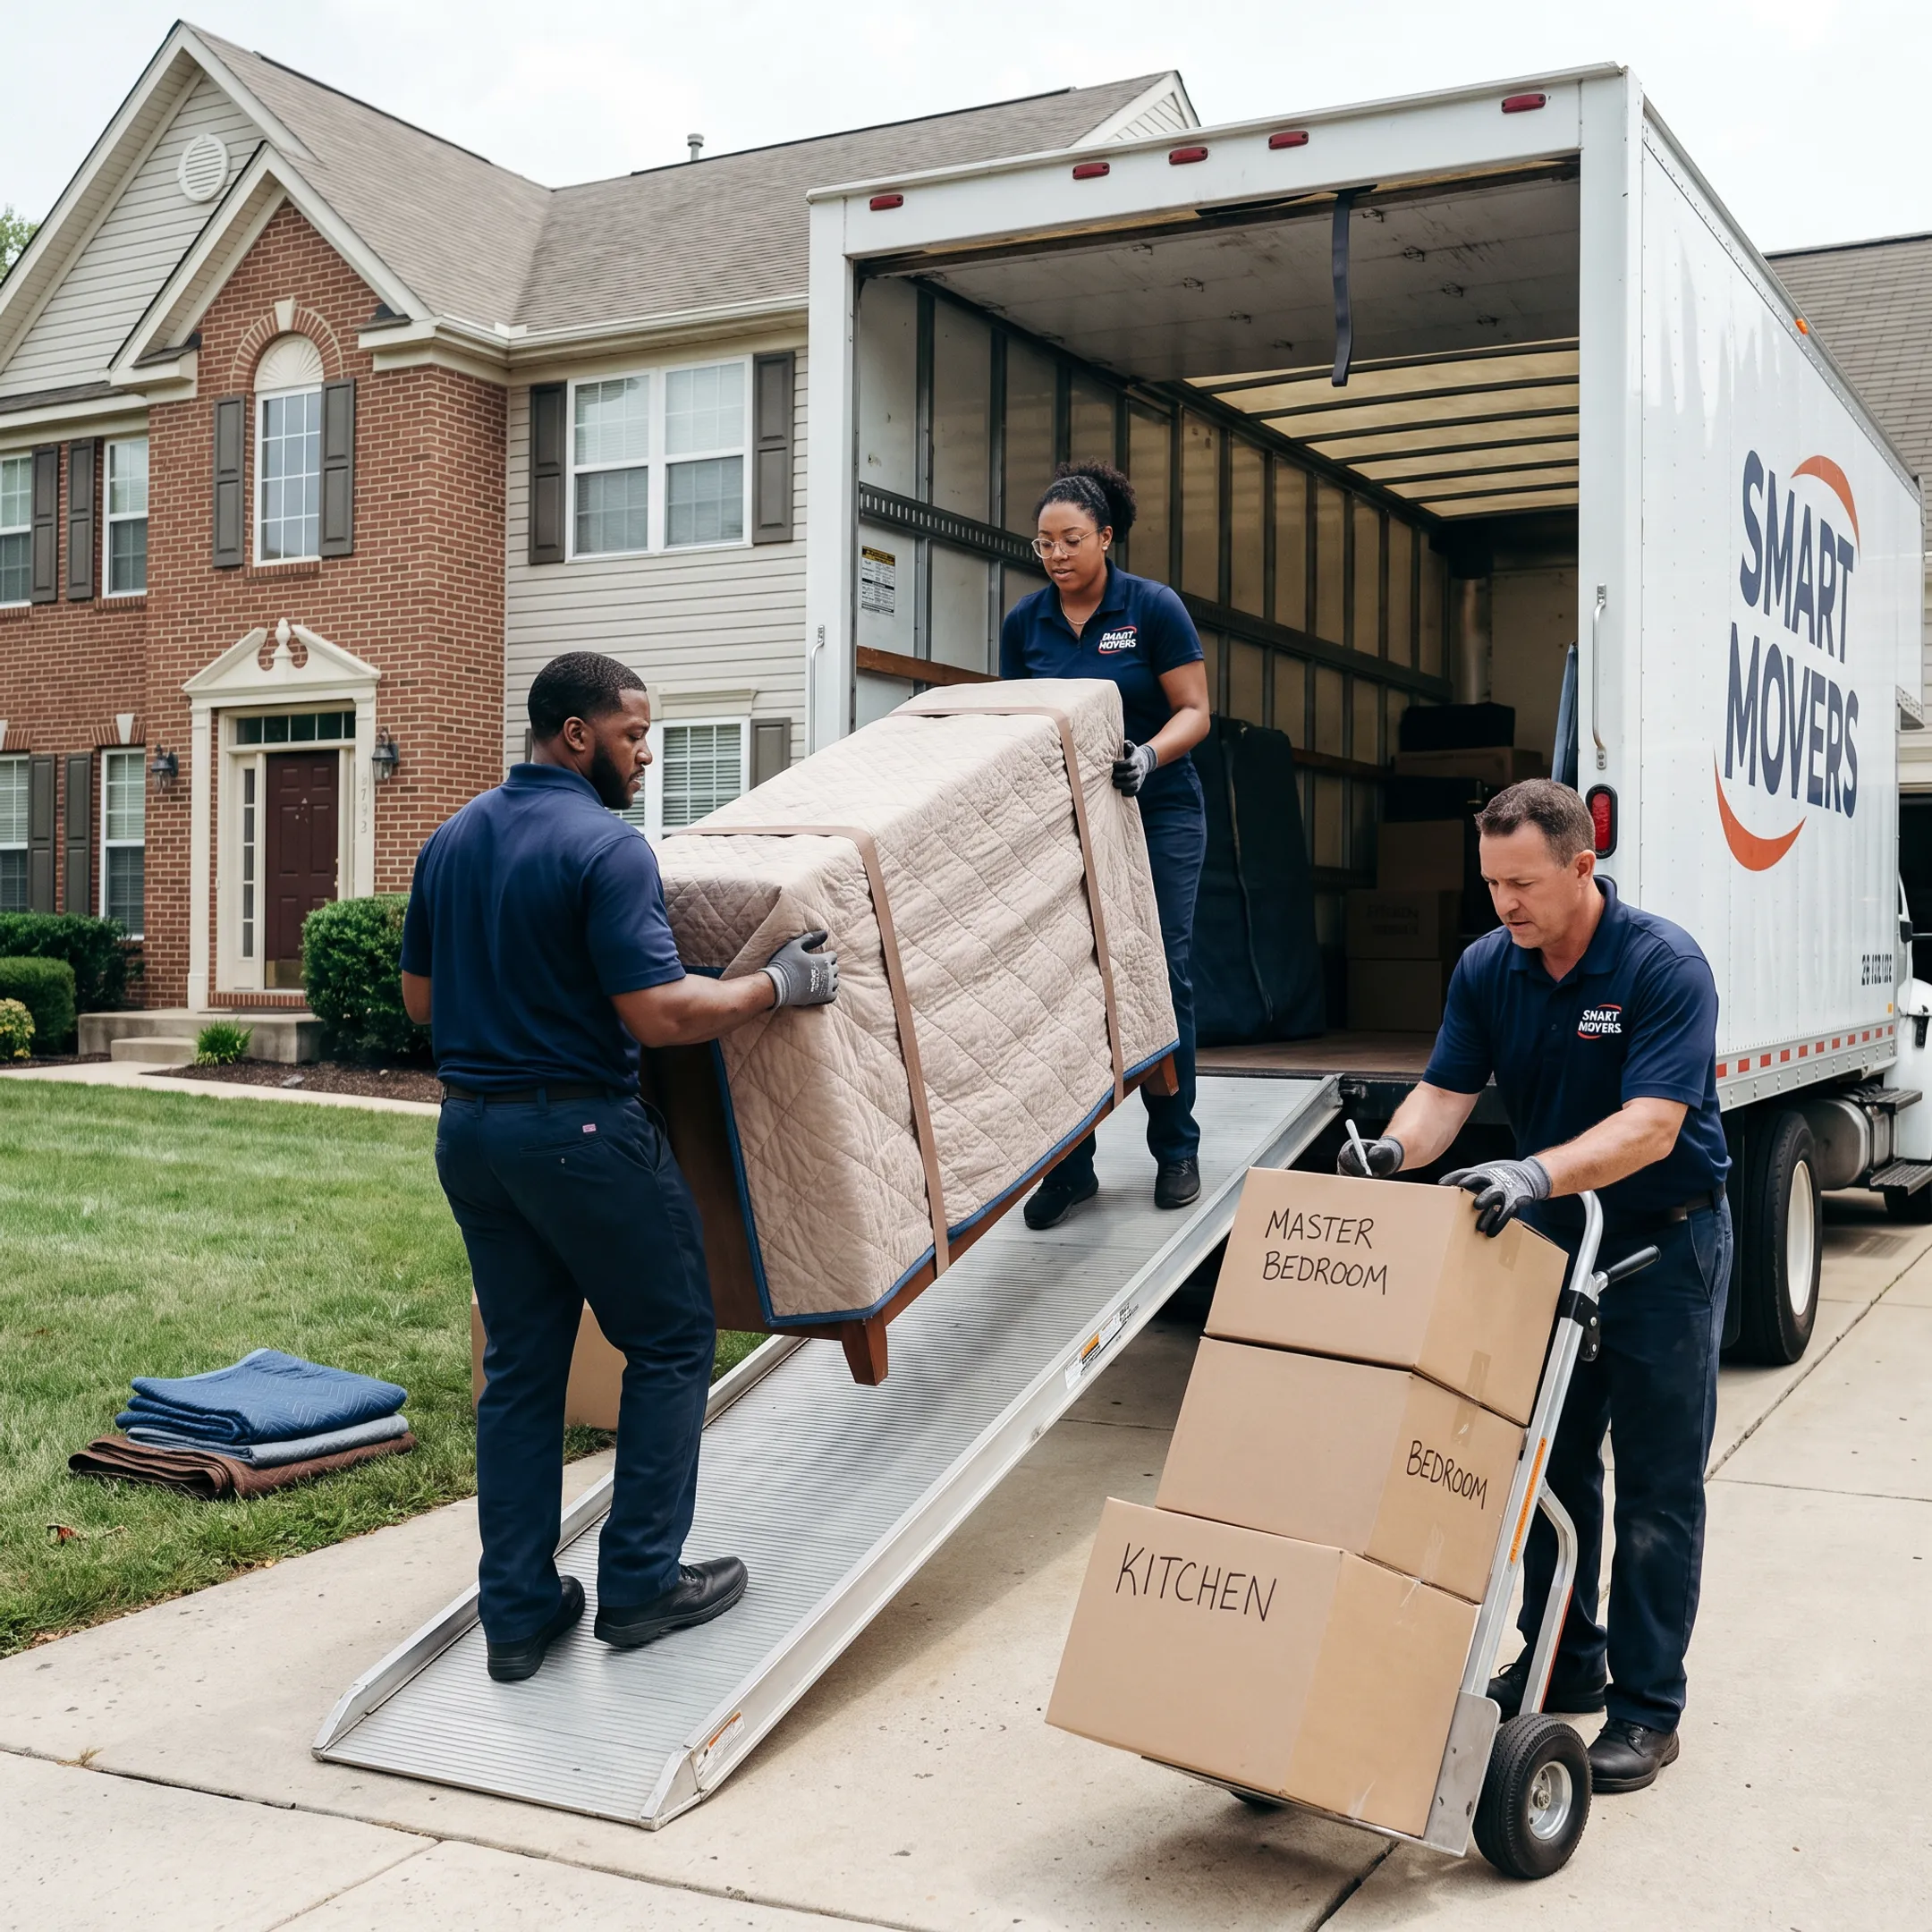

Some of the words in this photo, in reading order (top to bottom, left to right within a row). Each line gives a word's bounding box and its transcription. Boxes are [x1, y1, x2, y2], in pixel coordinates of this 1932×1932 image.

[1740, 450, 1854, 665] SMART
[1724, 622, 1859, 818] MOVERS
[1578, 1021, 1623, 1034] MOVERS
[1265, 1208, 1374, 1249] MASTER
[1262, 1250, 1387, 1295] BEDROOM
[1406, 1439, 1487, 1510] BEDROOM
[1115, 1542, 1277, 1622] KITCHEN
